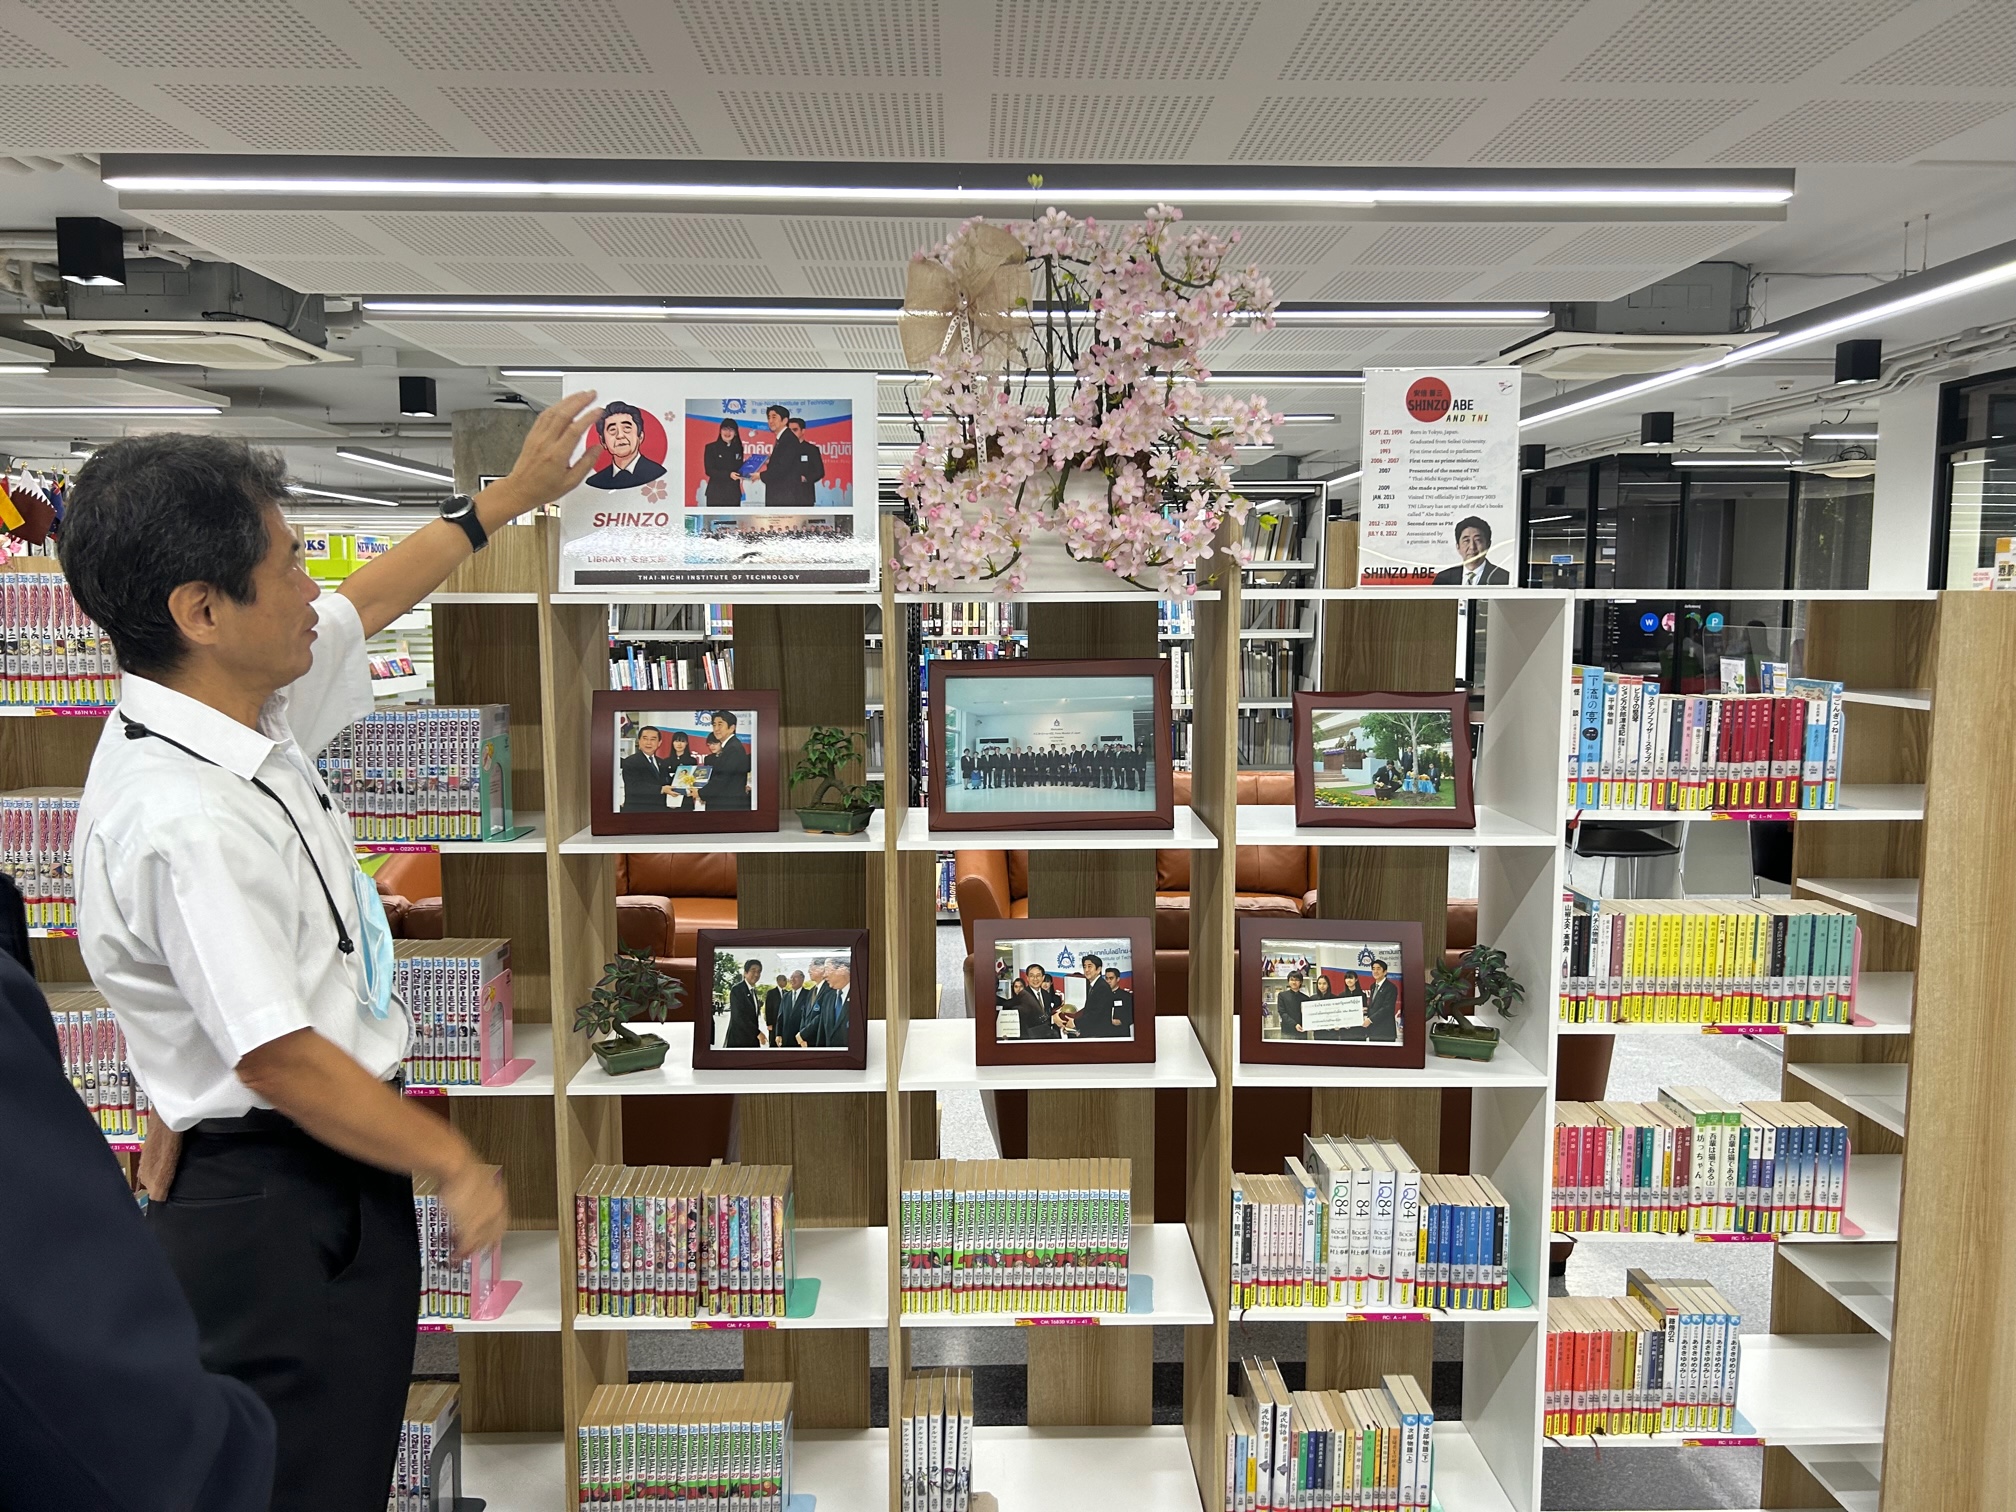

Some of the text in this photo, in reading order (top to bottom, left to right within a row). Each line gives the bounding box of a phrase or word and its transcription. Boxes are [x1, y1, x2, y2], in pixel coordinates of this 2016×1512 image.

[1408, 400, 1474, 411] SHINZO ABE
[593, 512, 669, 527] SHINZO
[304, 540, 326, 550] KS
[357, 542, 390, 554] NEW BOOKS
[1364, 566, 1436, 579] SHINZO ABE
[1711, 618, 1718, 626] P
[1586, 675, 1600, 724] 下流の宴
[1832, 698, 1840, 734] ごんぎつね
[355, 724, 364, 768] ONE PIECE
[387, 724, 395, 768] ONE PIECE
[408, 724, 416, 768] ONE PIECE
[418, 720, 426, 766] ONE PIECE
[472, 720, 480, 766] ONE PIECE
[331, 759, 340, 768] 10
[343, 759, 350, 768] 11
[1592, 913, 1600, 944] ハチ公物語
[413, 968, 421, 1012] ONE PIECE
[472, 969, 480, 1013] ONE PIECE
[1694, 1134, 1704, 1179] 坊っちゃん
[1332, 1180, 1349, 1216] 1Q84
[1376, 1180, 1392, 1217] 1Q84
[1400, 1182, 1418, 1218] 1Q84
[429, 1206, 437, 1248] ONE PIECE
[1668, 1318, 1676, 1342] 路傍の石
[1680, 1340, 1688, 1379] あさきゆめみし
[1690, 1340, 1698, 1379] あさきゆめみし
[1702, 1340, 1710, 1379] あさきゆめみし
[1714, 1340, 1722, 1379] あさきゆめみし
[1728, 1340, 1737, 1379] あさきゆめみし
[1261, 1408, 1270, 1432] 源氏物語
[1280, 1411, 1288, 1436] 源氏物語
[411, 1434, 419, 1474] ONE PIECE
